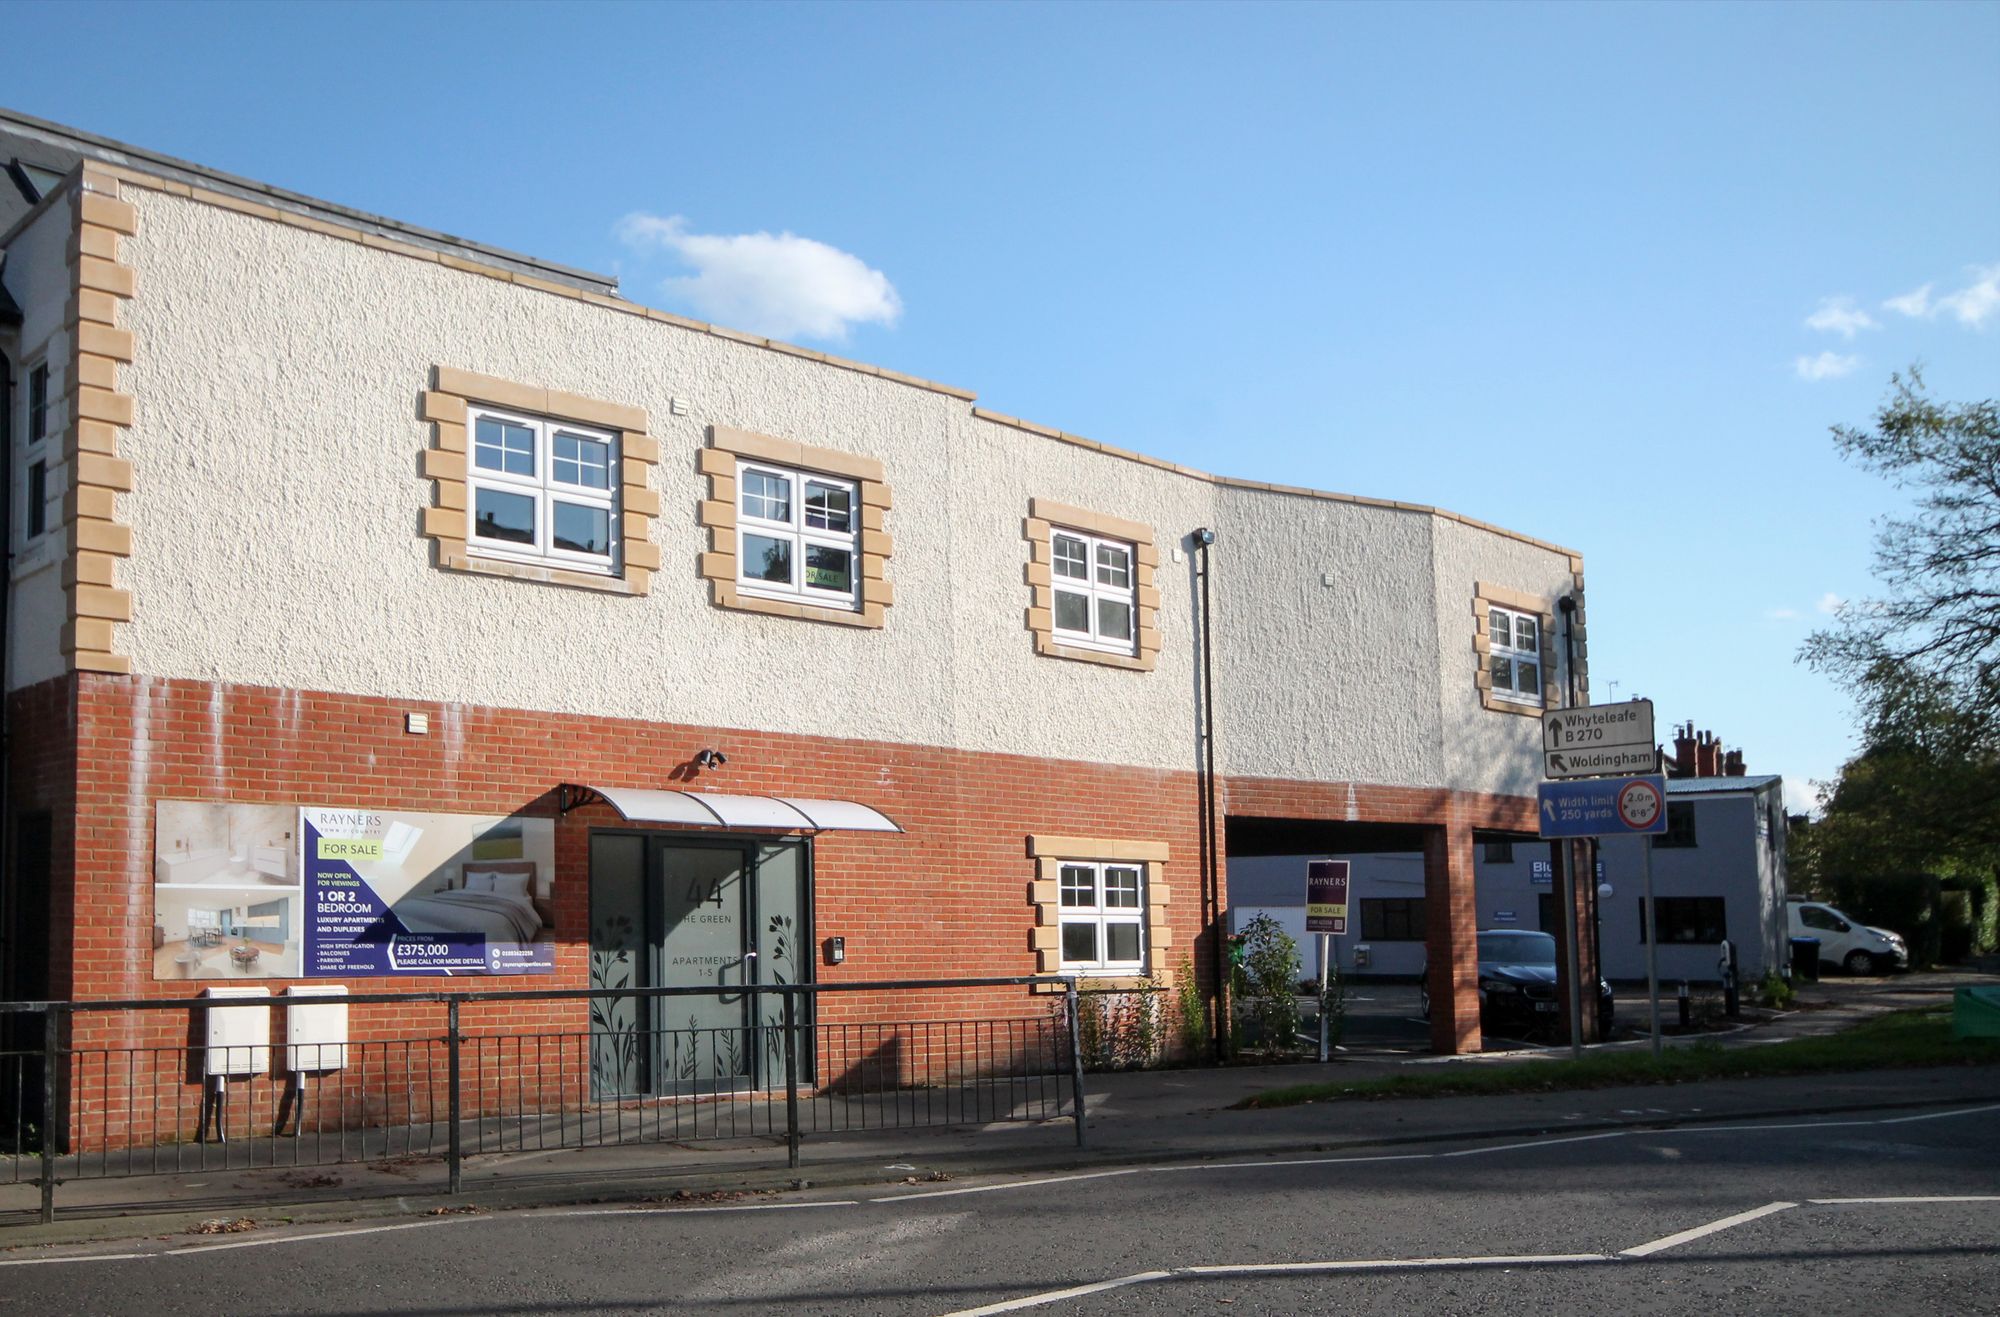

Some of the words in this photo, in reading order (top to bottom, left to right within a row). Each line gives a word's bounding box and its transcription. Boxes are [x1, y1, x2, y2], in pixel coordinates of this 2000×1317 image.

[818, 573, 839, 583] SALE
[1565, 709, 1637, 727] Whyteleafe
[1565, 731, 1574, 742] B
[1577, 728, 1603, 741] 270
[1569, 752, 1650, 768] Woldingham
[1558, 796, 1588, 808] Width
[1591, 795, 1614, 806] limit
[320, 813, 382, 826] RAYNERS
[1561, 810, 1581, 820] 250
[1584, 808, 1613, 821] yards
[324, 844, 347, 854] FOR
[350, 845, 378, 855] SALE
[1309, 877, 1346, 887] RAYNERS
[317, 891, 324, 902] 1
[327, 891, 345, 902] OR
[348, 891, 356, 902] 2
[686, 878, 723, 909] 44
[317, 903, 372, 913] BEDROOM
[1310, 906, 1323, 914] FOR
[700, 915, 731, 923] GREEN
[397, 944, 449, 957] £375,000
[672, 956, 739, 965] APARTMENTS
[699, 968, 713, 976] 1-5
